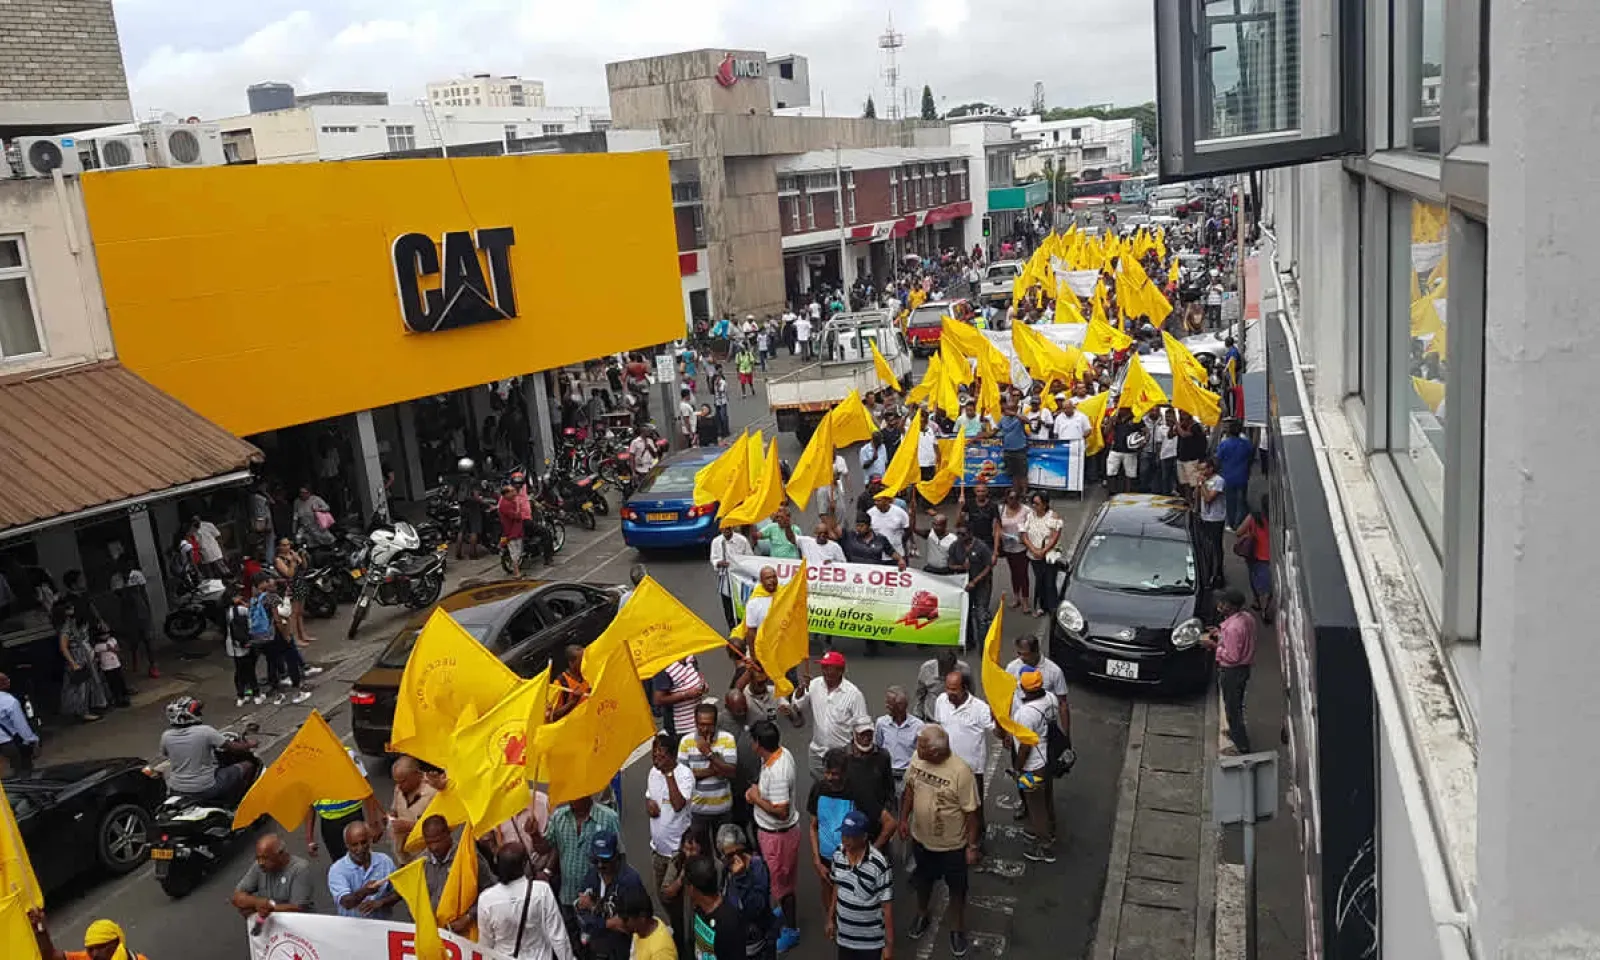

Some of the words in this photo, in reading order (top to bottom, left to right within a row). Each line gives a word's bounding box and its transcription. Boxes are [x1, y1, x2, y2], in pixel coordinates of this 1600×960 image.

[734, 59, 761, 77] MCB
[391, 227, 517, 332] CAT
[853, 573, 863, 584] &
[868, 570, 913, 588] OES
[808, 604, 832, 616] Nou
[836, 607, 874, 621] lafors
[839, 620, 895, 636] travayer
